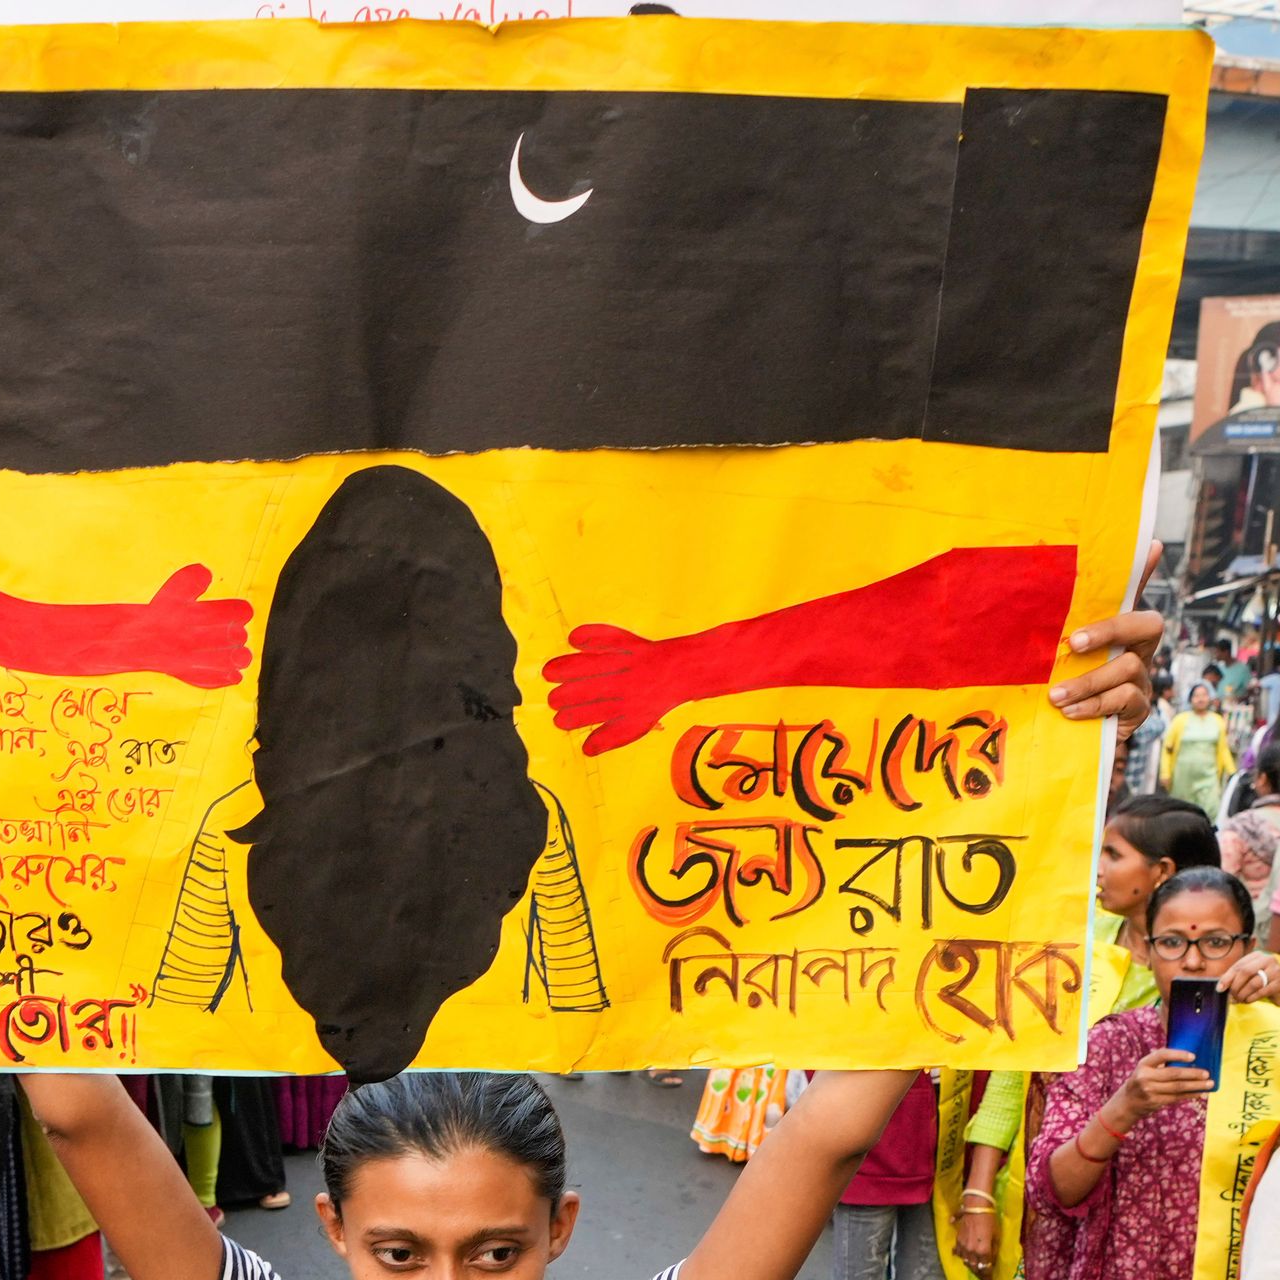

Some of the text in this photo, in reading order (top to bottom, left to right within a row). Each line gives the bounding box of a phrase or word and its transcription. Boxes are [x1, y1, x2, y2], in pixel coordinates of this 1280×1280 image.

[120, 738, 187, 774] রাত
[670, 708, 1010, 821] মেয়েদের
[627, 816, 1030, 937] জন্য রাত
[662, 925, 1086, 1044] নিরাপদ হোক
